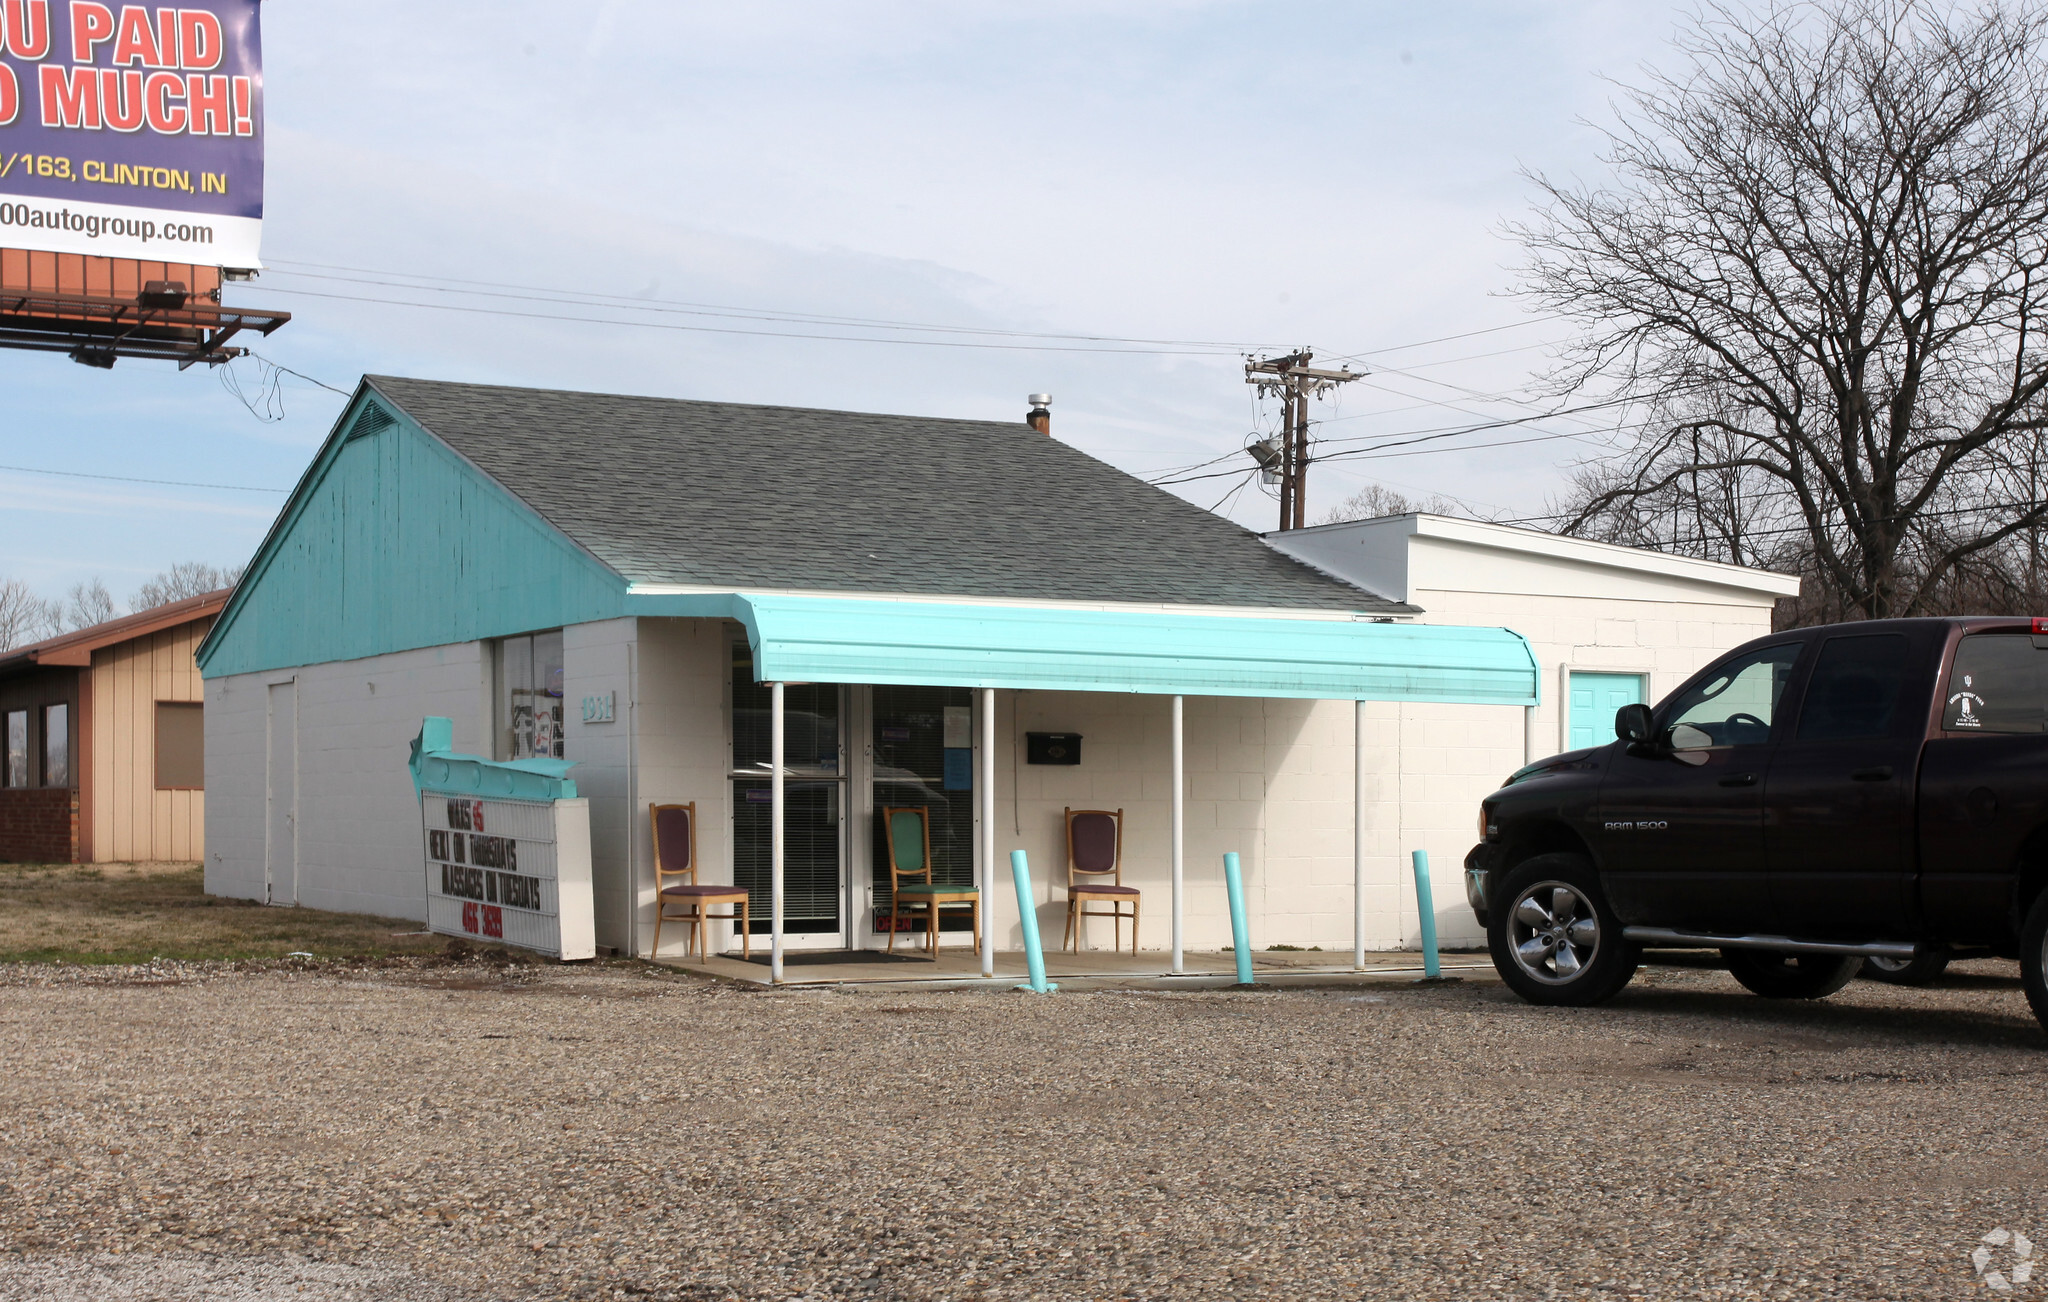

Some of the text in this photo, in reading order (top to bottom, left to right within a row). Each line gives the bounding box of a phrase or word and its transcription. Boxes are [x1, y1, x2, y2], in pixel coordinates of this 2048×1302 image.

[70, 0, 223, 71] PAID
[38, 63, 253, 137] MUCH!
[0, 153, 226, 194] /163, CLINTON, IN
[1604, 820, 1668, 831] RAM 1500
[469, 834, 517, 872] THURSDAYS
[441, 863, 484, 901] MASSAGES
[498, 872, 541, 911] TUESDAYS
[462, 900, 479, 934] 466
